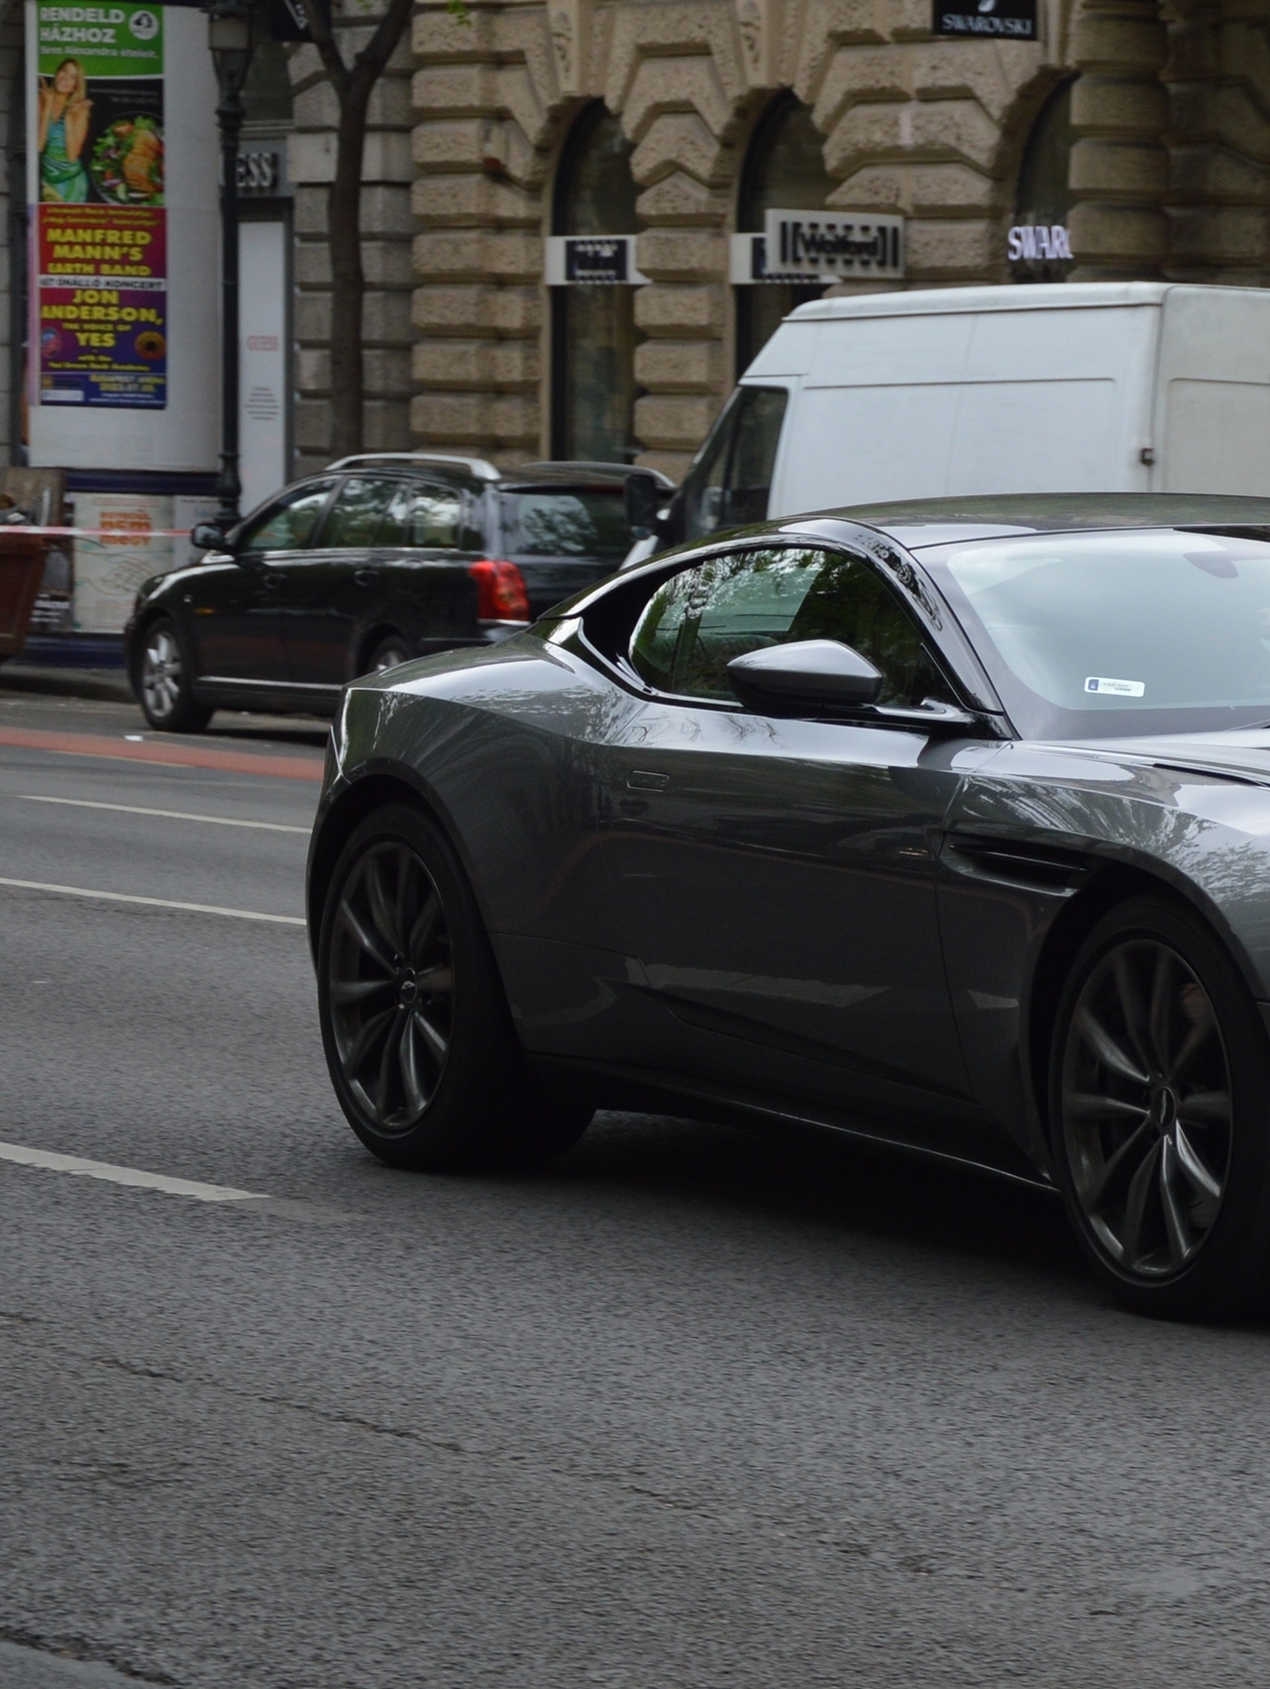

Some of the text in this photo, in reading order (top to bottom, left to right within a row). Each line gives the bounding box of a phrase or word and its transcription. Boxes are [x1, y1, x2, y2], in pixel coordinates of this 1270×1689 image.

[40, 7, 126, 23] RENDELD
[942, 13, 1032, 35] SWAROVSKI
[40, 24, 117, 43] HÁZHOZ
[46, 228, 152, 245] MANFRED
[100, 264, 152, 276] BAND
[72, 290, 119, 304] JON
[76, 332, 116, 347] YES
